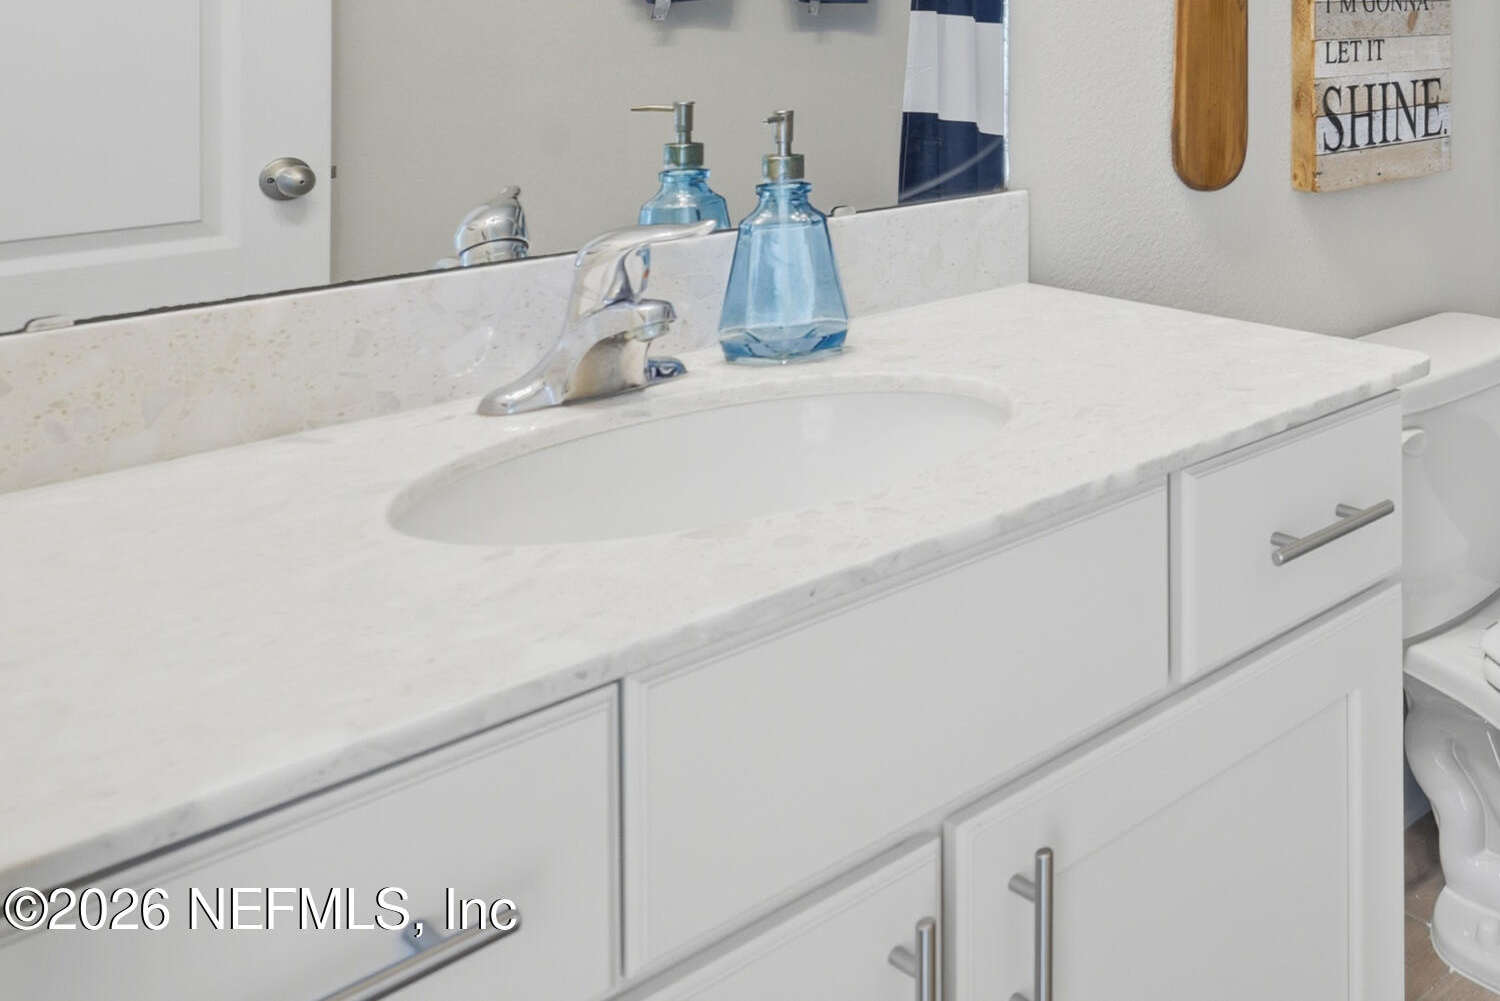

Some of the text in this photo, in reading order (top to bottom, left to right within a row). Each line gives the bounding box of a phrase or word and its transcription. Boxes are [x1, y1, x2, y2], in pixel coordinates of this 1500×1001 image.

[1325, 39, 1385, 64] LET IT
[1322, 78, 1447, 152] SHINE.
